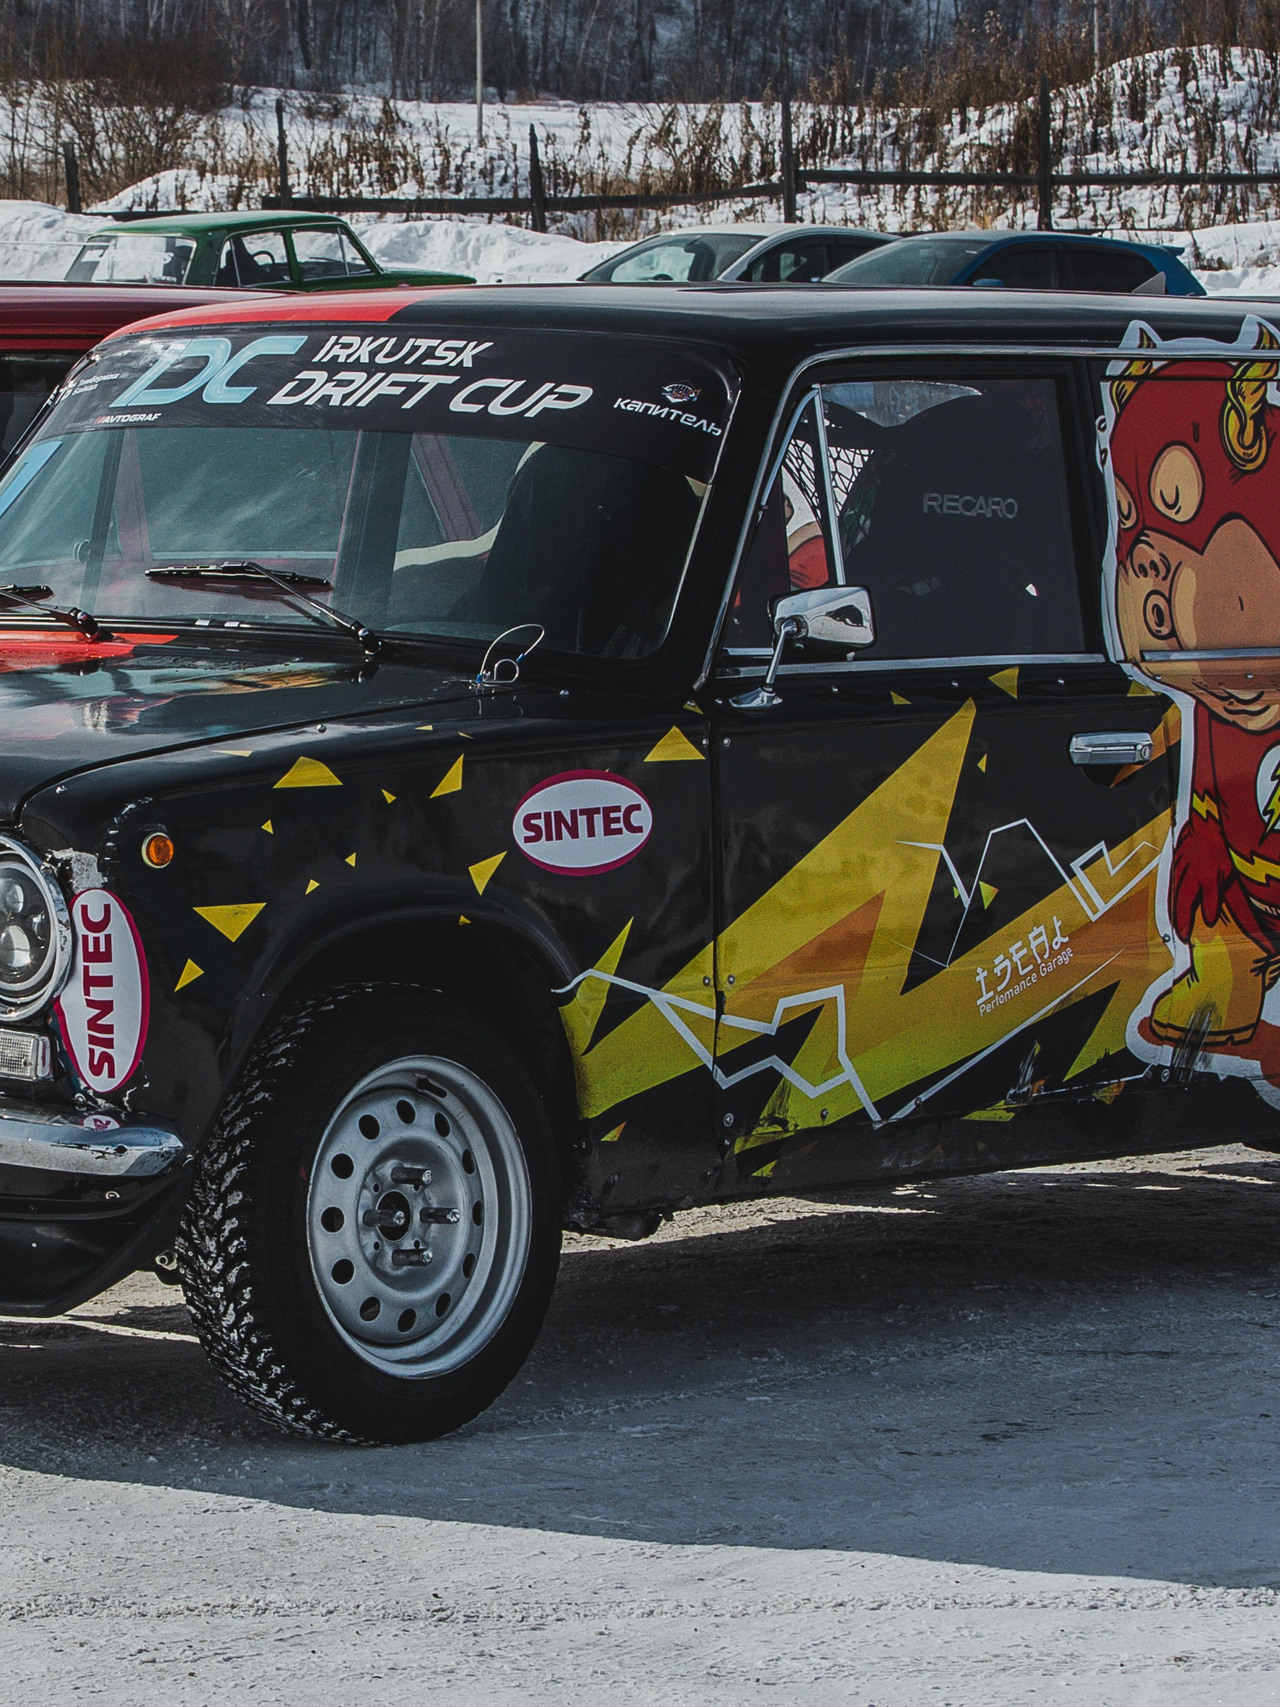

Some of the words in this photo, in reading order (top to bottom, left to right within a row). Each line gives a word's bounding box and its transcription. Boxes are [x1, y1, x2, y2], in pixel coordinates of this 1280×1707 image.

[312, 335, 494, 367] IRKUTSK
[109, 335, 308, 408] DC
[266, 370, 460, 409] DRIFT
[449, 378, 593, 418] CUP
[101, 413, 162, 424] AVTOGRAF
[922, 492, 1019, 519] RECARO
[522, 803, 644, 844] SINTEC
[1039, 947, 1074, 977] Garage
[80, 903, 116, 1079] SINTEC
